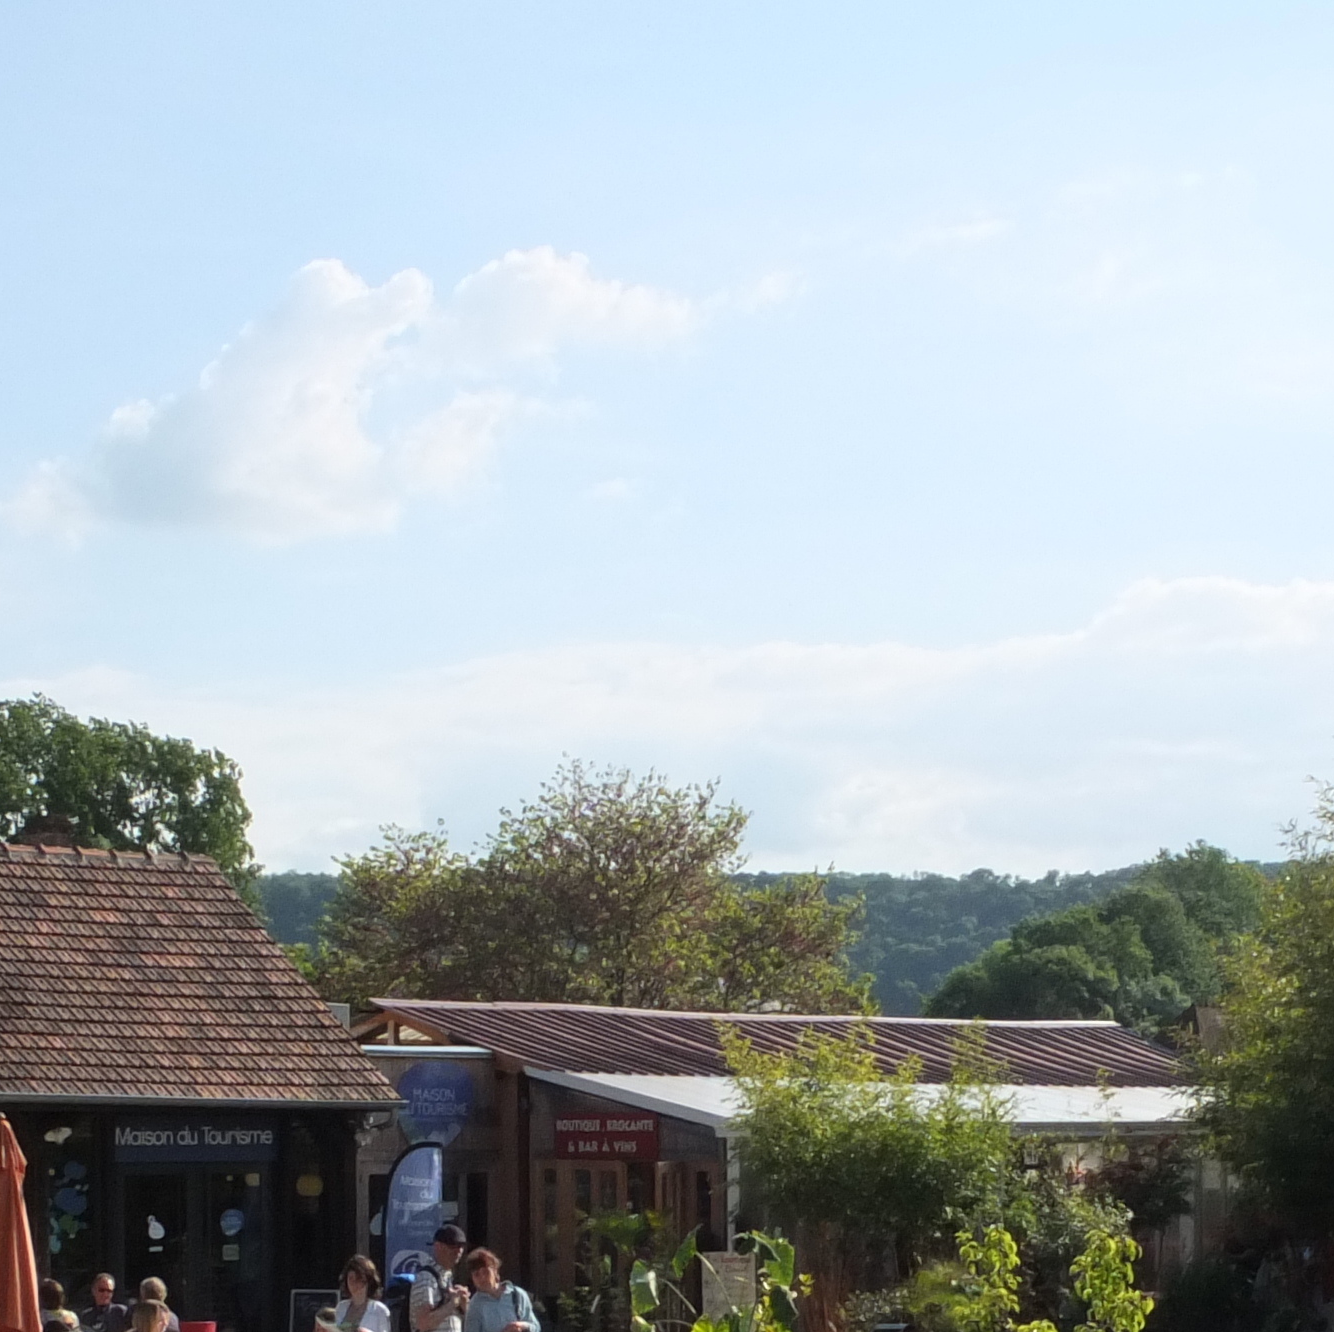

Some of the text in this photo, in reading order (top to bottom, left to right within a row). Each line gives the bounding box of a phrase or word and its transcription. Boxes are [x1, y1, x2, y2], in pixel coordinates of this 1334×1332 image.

[412, 1088, 455, 1102] MAISON
[606, 1119, 654, 1132] BROCANTE
[115, 1125, 273, 1146] Maison du Tourisme
[578, 1140, 598, 1153] BAR
[613, 1140, 637, 1153] VINS
